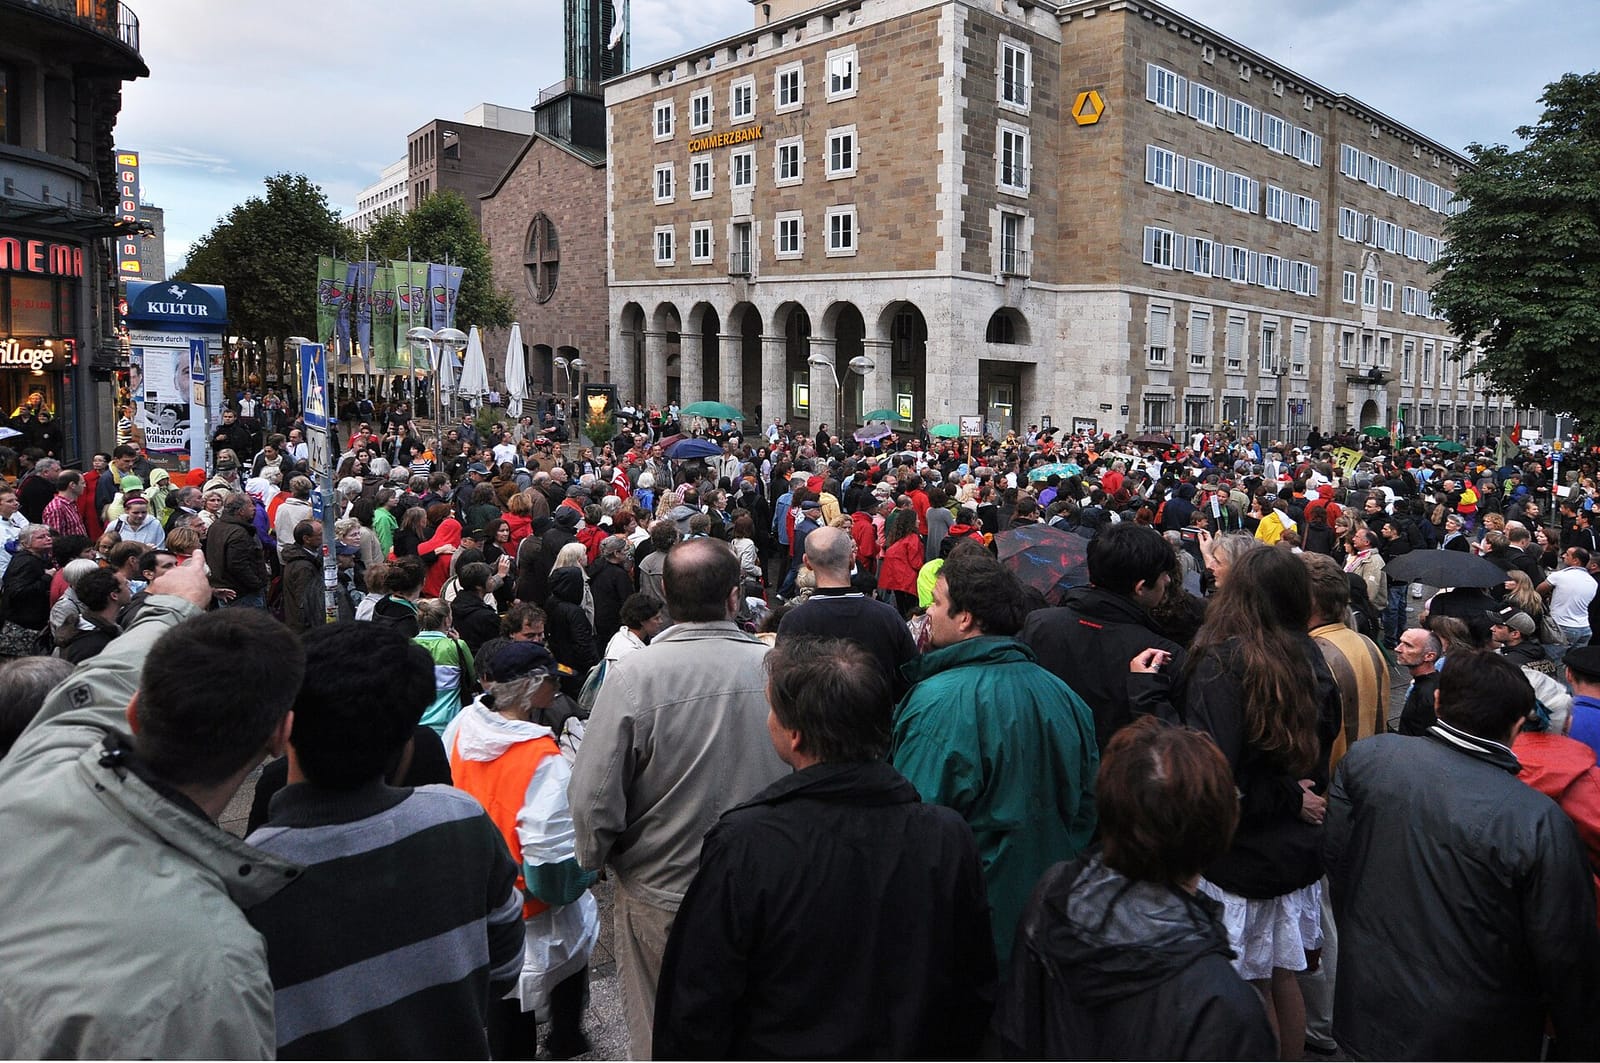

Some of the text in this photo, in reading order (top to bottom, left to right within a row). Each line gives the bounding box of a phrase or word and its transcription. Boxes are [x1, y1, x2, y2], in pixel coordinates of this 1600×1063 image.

[688, 125, 763, 153] COMMERZBANK
[147, 301, 208, 316] KULTUR
[146, 427, 183, 436] Rolando
[146, 435, 182, 444] Villazón
